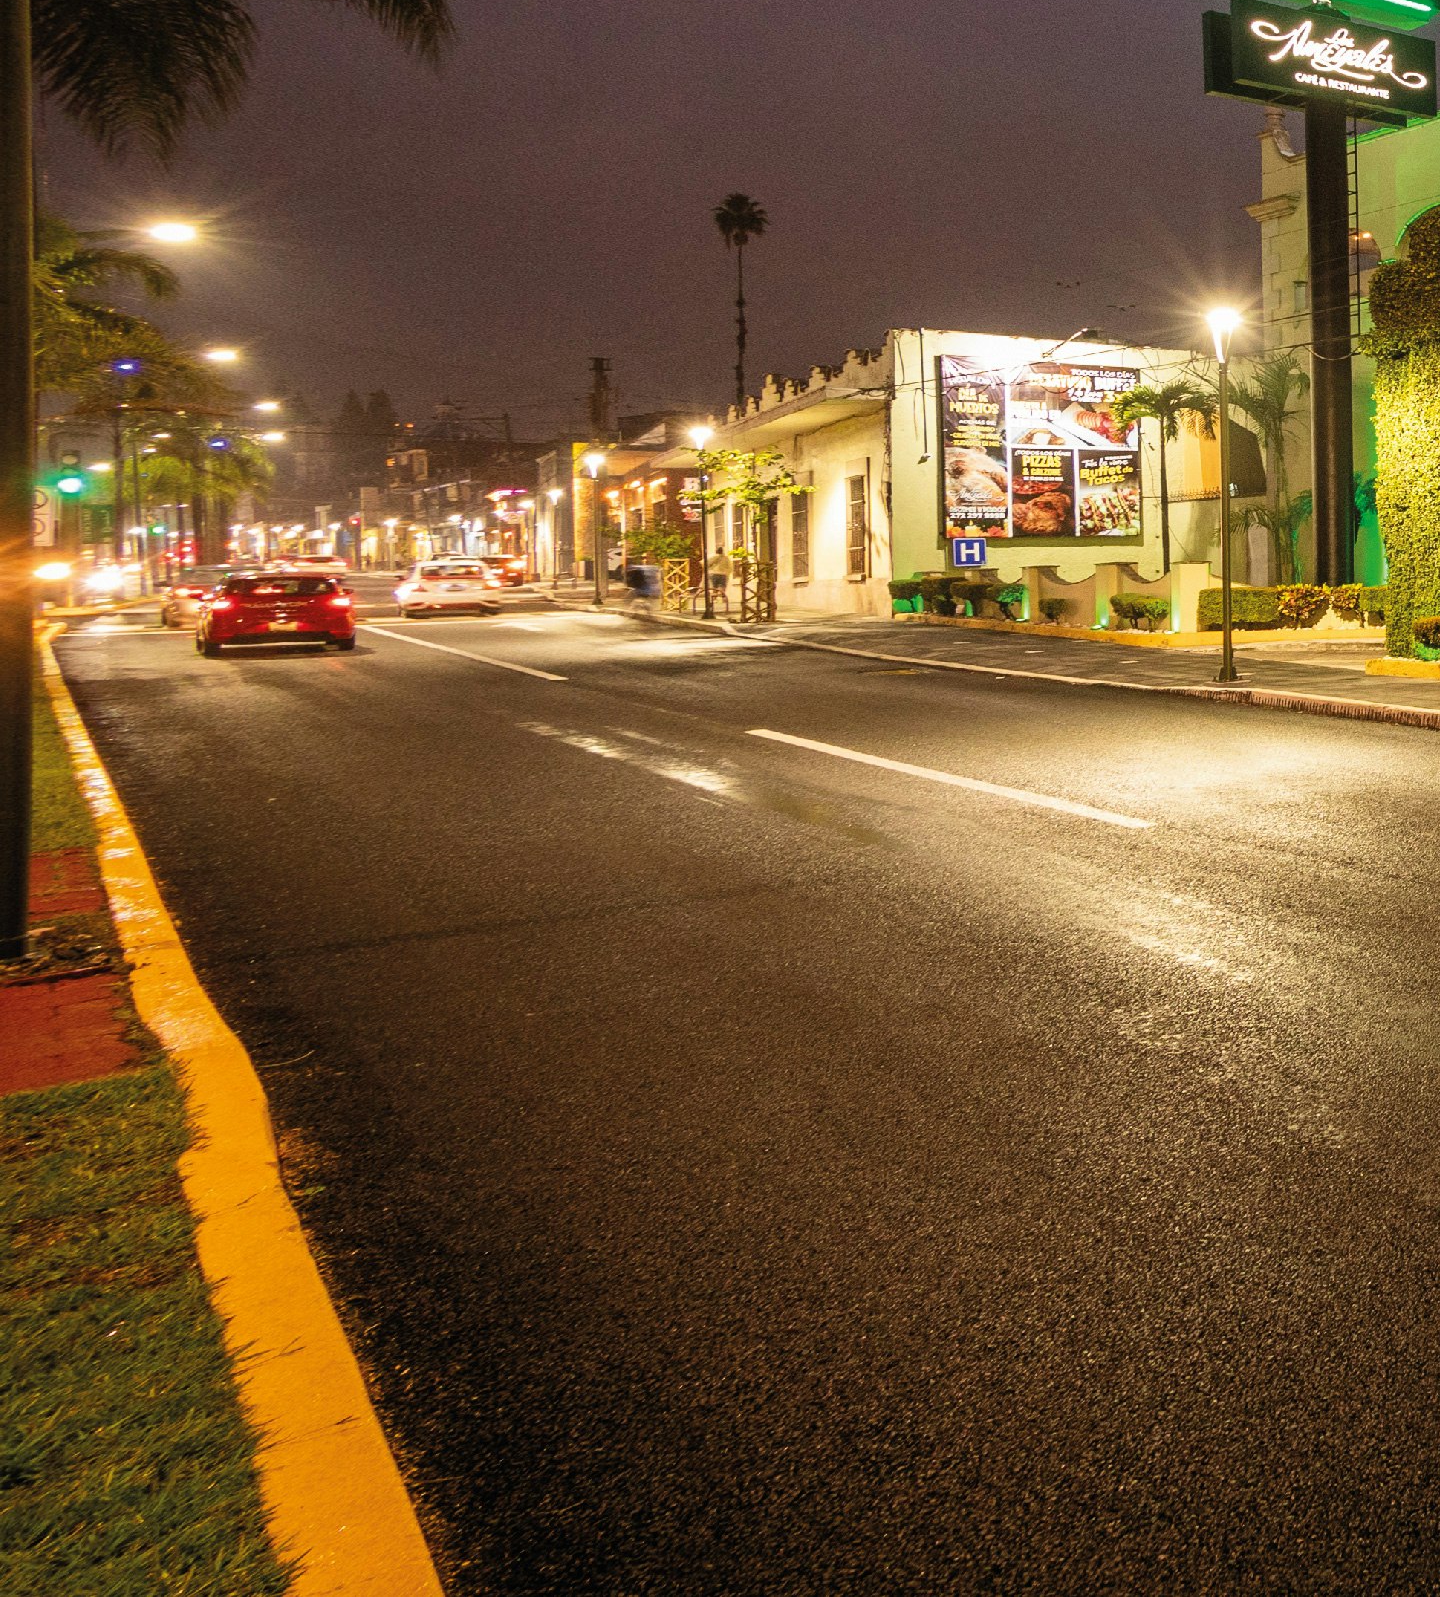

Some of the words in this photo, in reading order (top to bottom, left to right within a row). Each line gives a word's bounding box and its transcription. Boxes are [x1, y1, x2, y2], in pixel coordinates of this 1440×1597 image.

[1328, 79, 1390, 100] RESTAURANTE
[1070, 369, 1098, 377] TODOS
[1099, 370, 1115, 378] LOS
[949, 401, 1000, 415] MUERTOS
[1022, 455, 1062, 467] PIZZAS
[1022, 467, 1030, 476] &
[1080, 465, 1122, 479] Buffet
[1122, 466, 1133, 474] de
[960, 542, 980, 562] H
